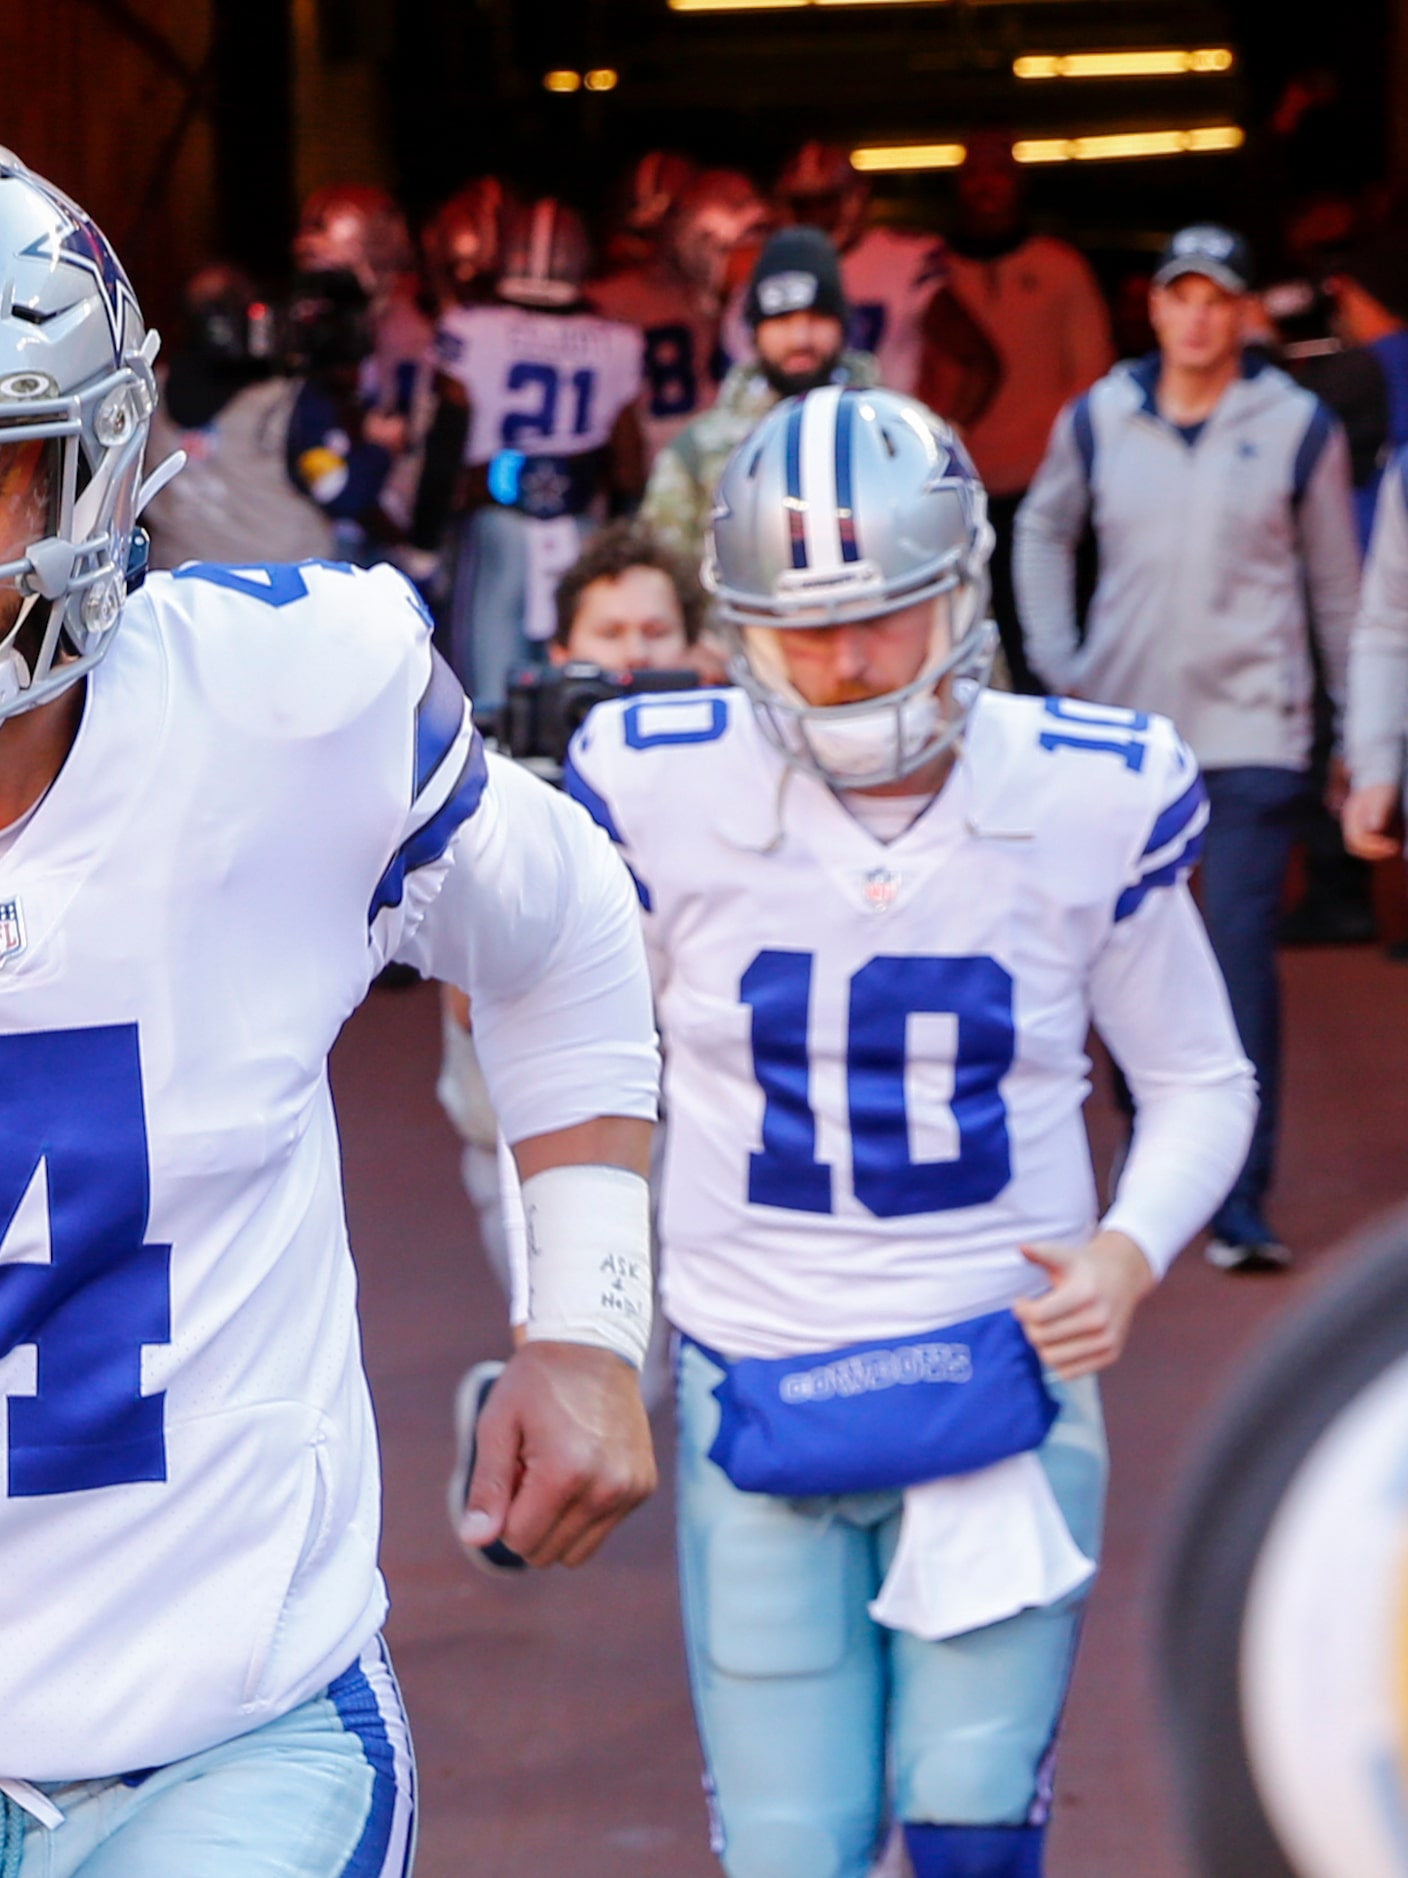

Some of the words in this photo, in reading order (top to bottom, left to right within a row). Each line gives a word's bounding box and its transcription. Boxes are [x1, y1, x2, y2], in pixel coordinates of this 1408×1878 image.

[501, 362, 596, 450] 21
[738, 949, 1017, 1218] 10
[780, 1343, 974, 1404] COWBOYS
